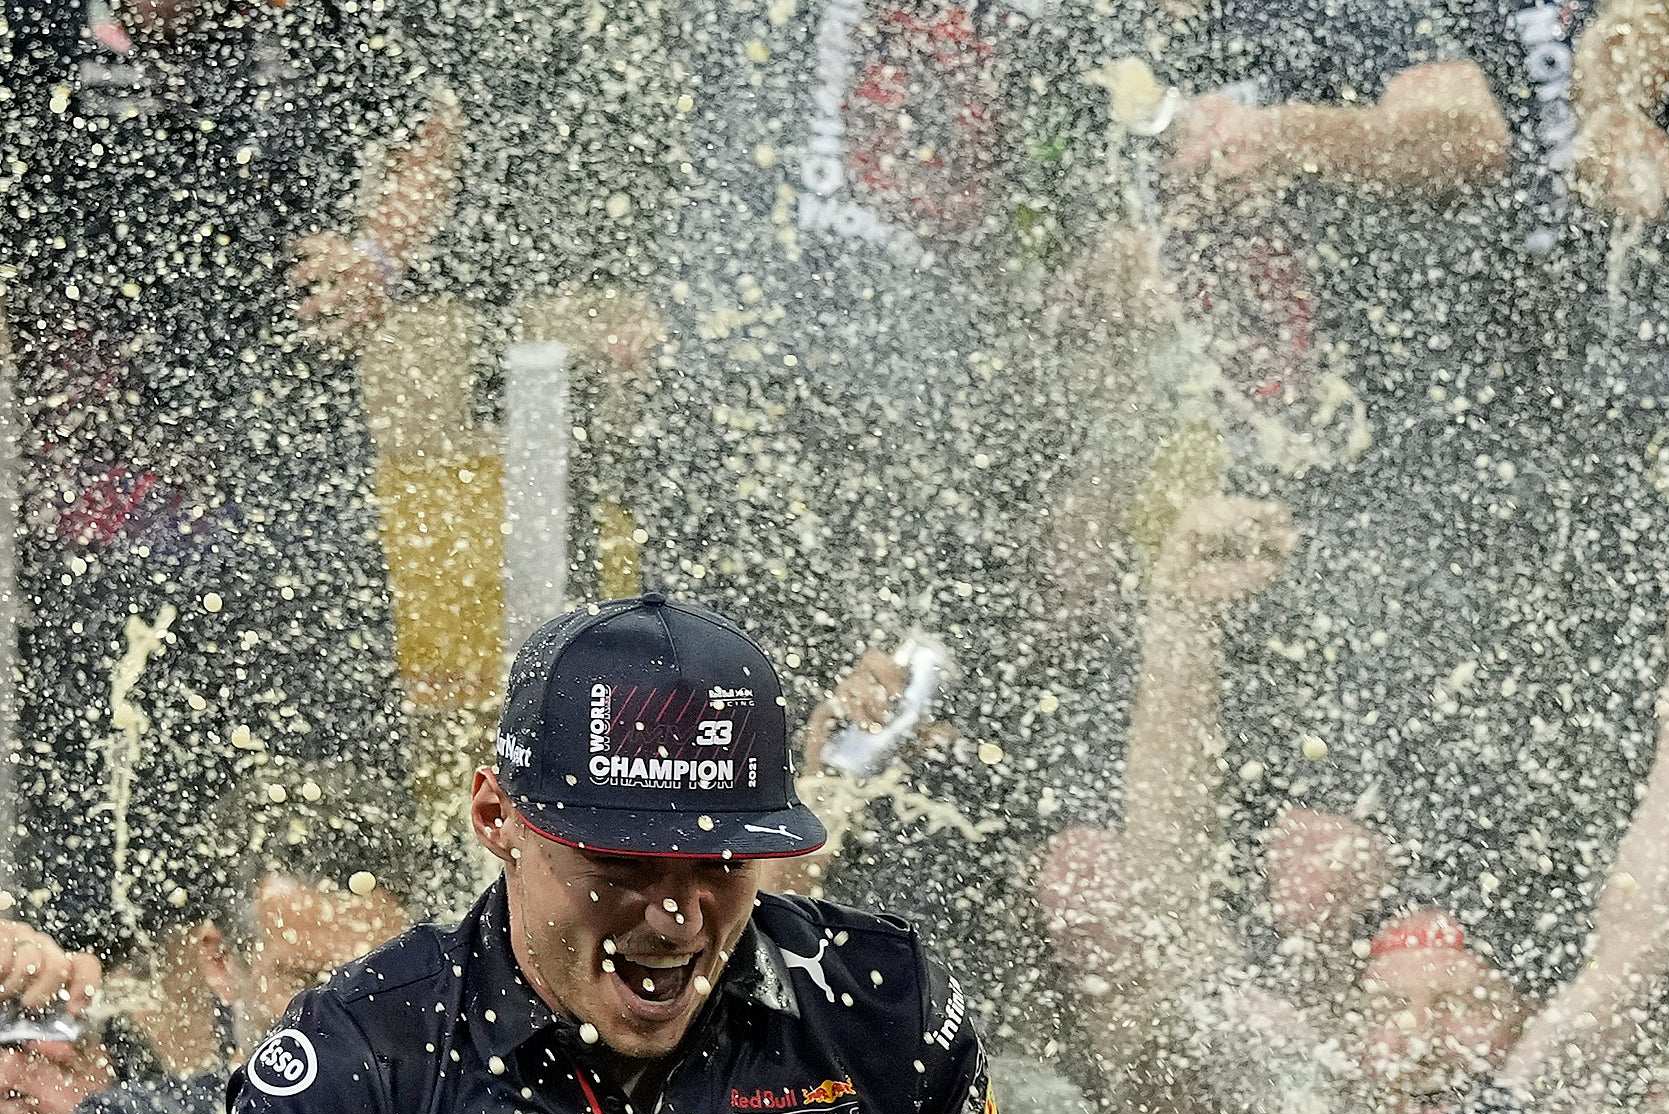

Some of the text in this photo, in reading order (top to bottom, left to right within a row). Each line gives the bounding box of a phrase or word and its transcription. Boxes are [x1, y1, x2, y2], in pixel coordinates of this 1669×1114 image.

[590, 683, 610, 752] WORLD
[697, 720, 733, 746] 33
[589, 756, 734, 788] CHAMPION
[748, 757, 757, 788] 2021
